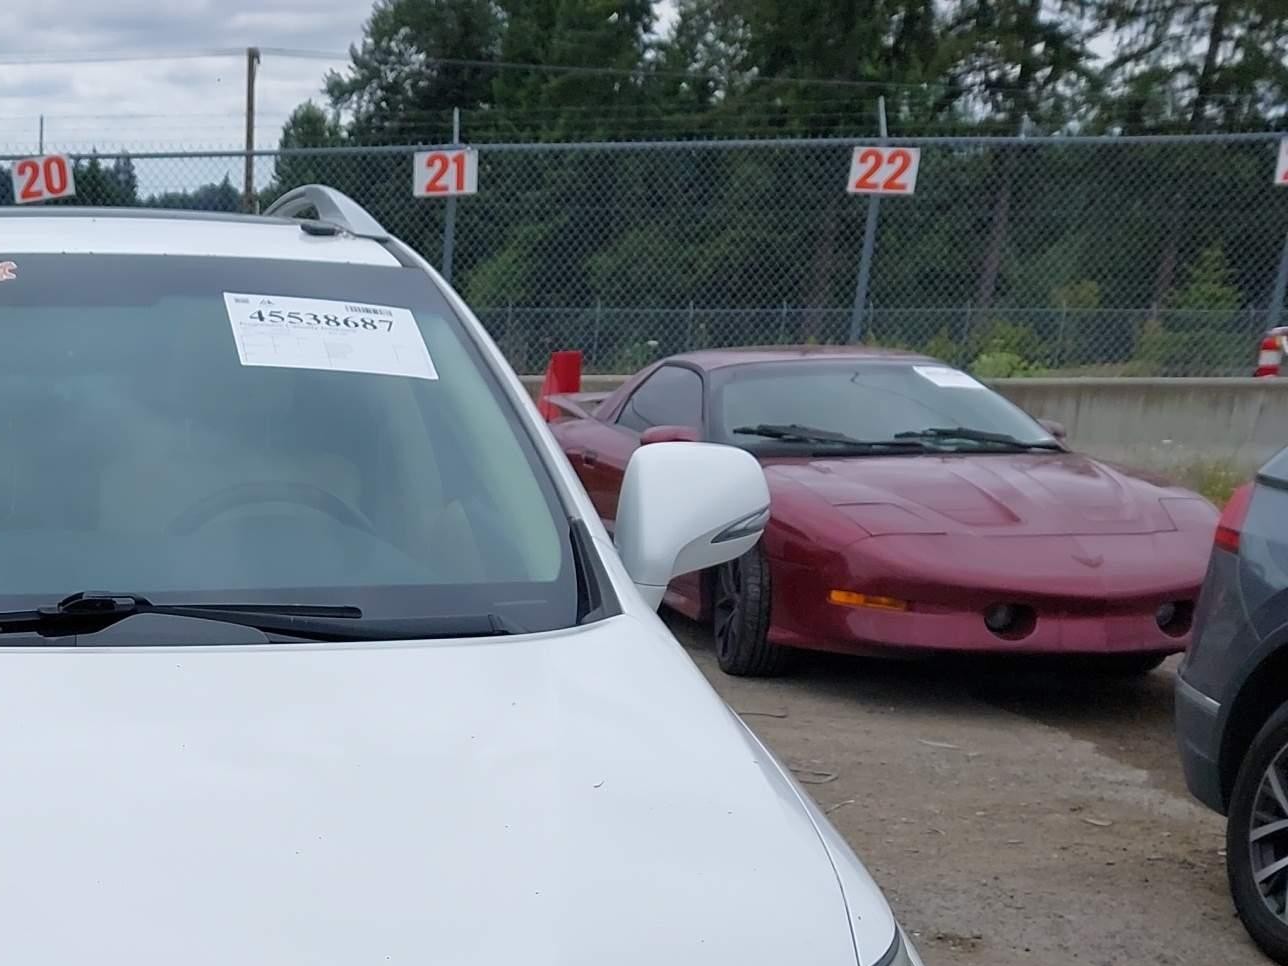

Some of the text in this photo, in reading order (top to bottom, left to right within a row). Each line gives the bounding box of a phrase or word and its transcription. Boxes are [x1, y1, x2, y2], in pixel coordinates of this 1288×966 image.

[16, 156, 69, 200] 20
[424, 153, 466, 193] 21
[855, 148, 911, 191] 22
[248, 309, 394, 332] 45538687
